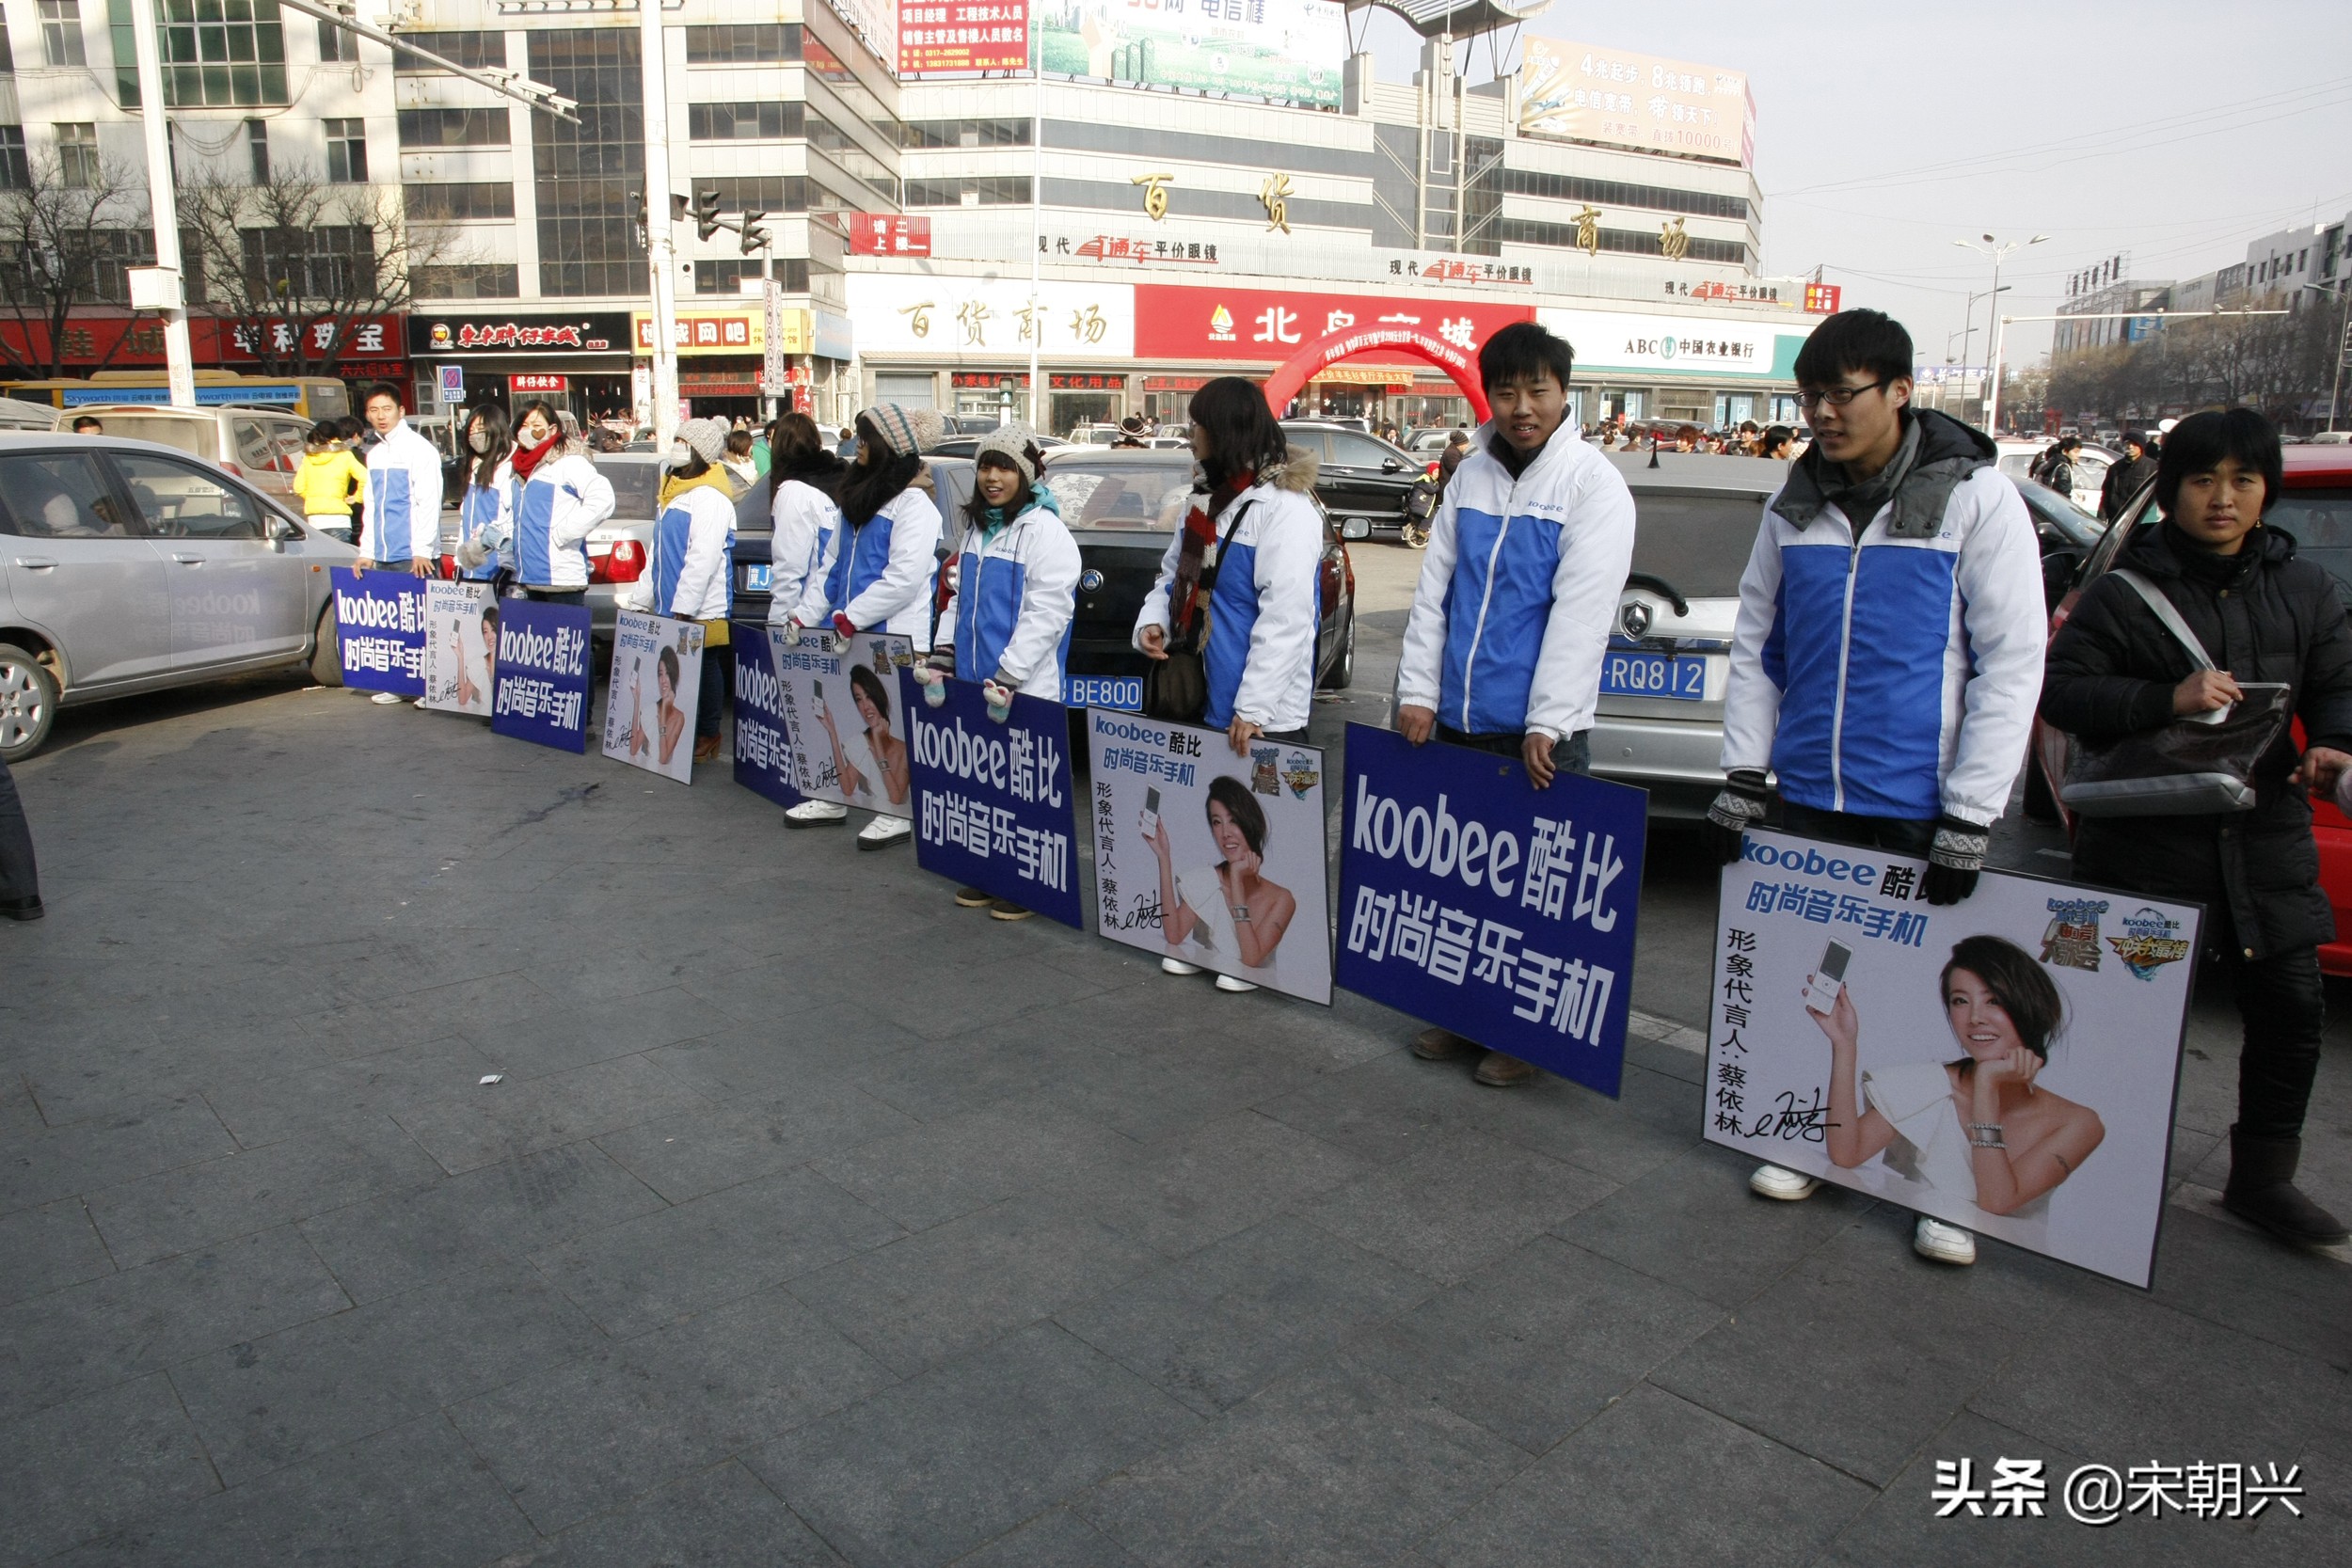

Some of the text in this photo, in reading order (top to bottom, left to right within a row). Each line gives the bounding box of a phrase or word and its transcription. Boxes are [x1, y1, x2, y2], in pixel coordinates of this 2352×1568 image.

[902, 6, 1023, 23] 项目经理 工程技术人员
[902, 27, 1023, 45] 销售主管及售楼人员数名
[1253, 307, 1478, 351] 北岛城
[1625, 339, 1658, 354] ABC
[1679, 338, 1755, 358] 中国农业银行
[1050, 374, 1122, 389] 文化用品
[430, 584, 481, 599] koobee 酷比
[337, 589, 398, 630] koobee
[434, 599, 478, 616] 时尚音乐手机
[619, 613, 660, 636] koobee 酷比
[500, 621, 584, 676] koobee 酷比
[620, 632, 657, 655] 时尚音乐手机
[820, 635, 834, 653] 酷
[782, 653, 841, 676] 时尚音乐手机
[736, 653, 777, 715] koobee
[497, 675, 582, 732] 时尚音乐手机
[1096, 715, 1202, 758] koobee 酷比
[911, 706, 1062, 809] koobee 酷比
[1104, 747, 1196, 787] 时尚音乐手机
[922, 789, 1067, 893] 时尚音乐手机
[1353, 773, 1624, 933] koobee 酷比
[1740, 835, 1876, 887] koobee
[1745, 880, 1929, 948] 时尚音乐手机
[2047, 897, 2110, 913] koobee
[2122, 917, 2164, 928] koobee
[1347, 884, 1614, 1047] 时尚音乐手机
